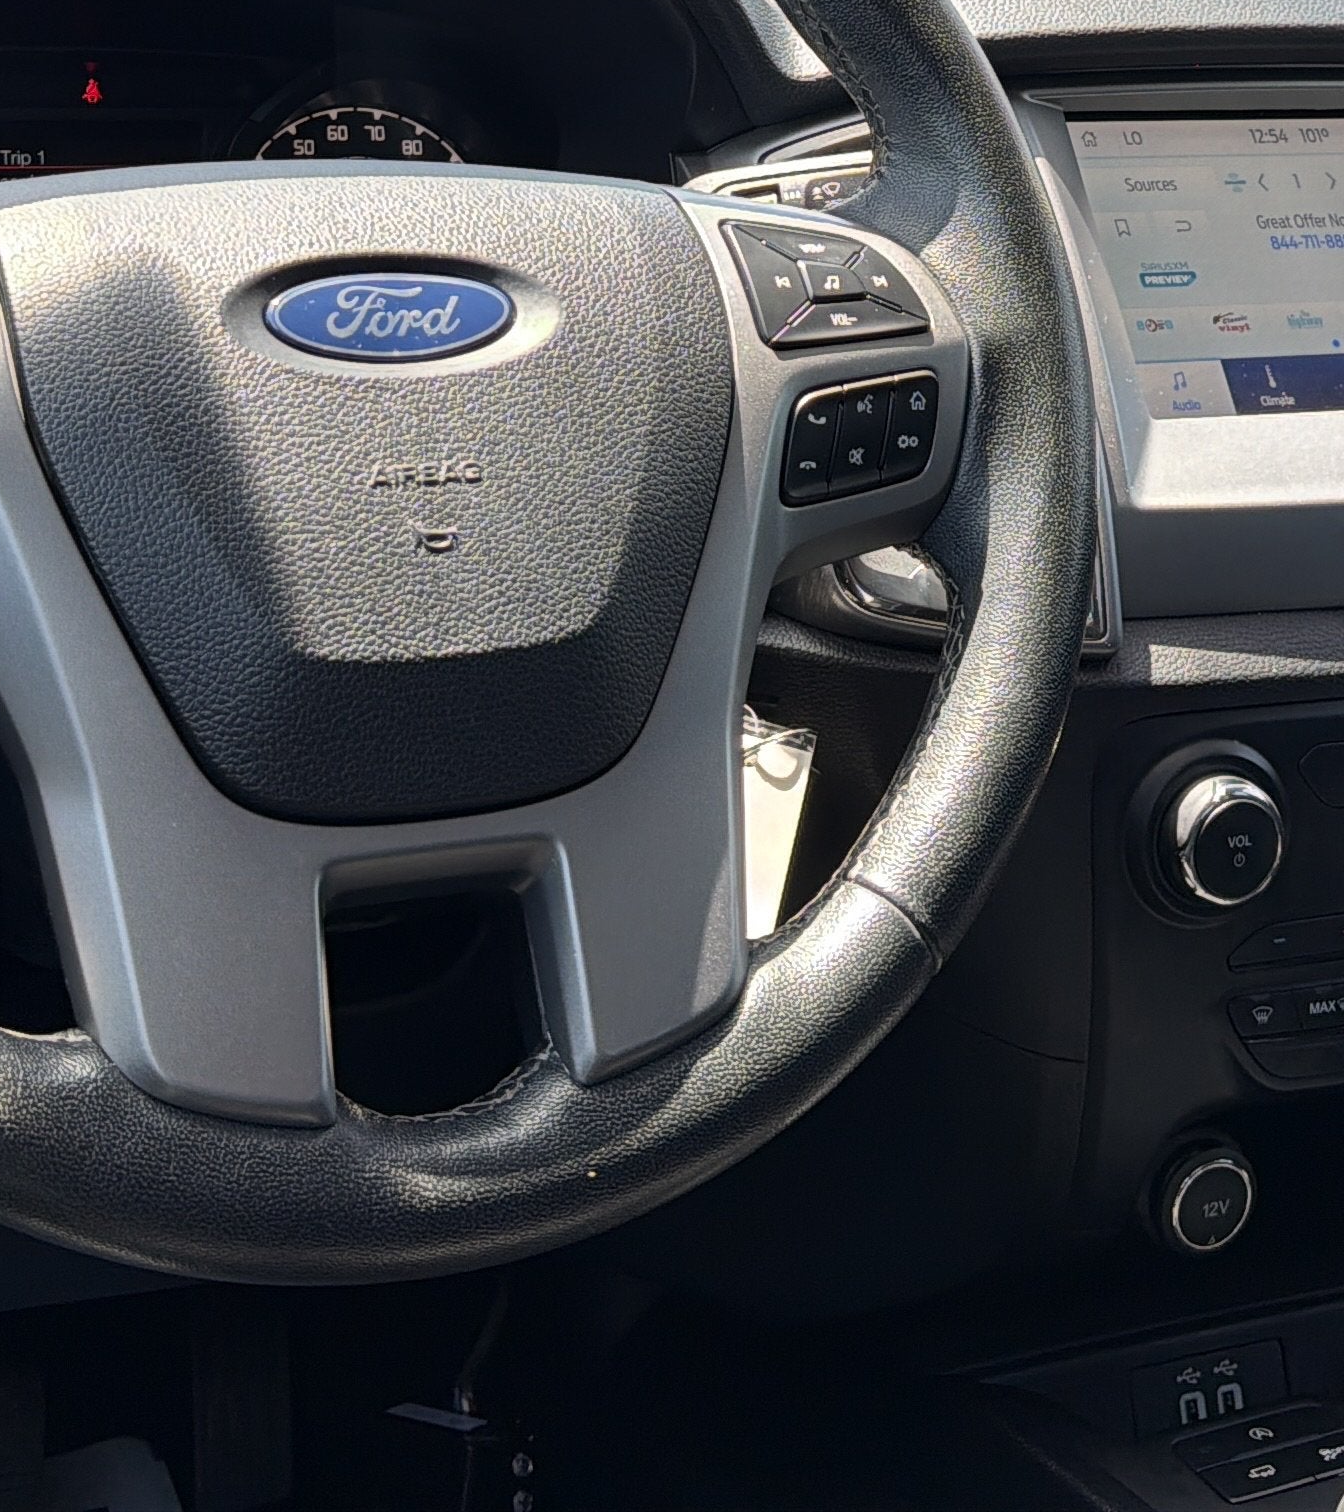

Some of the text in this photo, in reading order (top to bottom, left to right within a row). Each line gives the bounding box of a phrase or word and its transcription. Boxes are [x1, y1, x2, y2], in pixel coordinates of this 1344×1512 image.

[326, 125, 349, 141] 60
[363, 125, 386, 141] 70
[1123, 131, 1143, 146] LO
[1249, 128, 1289, 144] 12:54
[293, 139, 315, 156] 50
[401, 139, 423, 156] 80
[0, 150, 46, 167] Trip 1
[1124, 177, 1178, 193] Sources
[1256, 215, 1293, 230] Great
[1293, 214, 1327, 229] Offer
[1144, 274, 1192, 285] PREVIEW
[326, 285, 460, 338] Ford
[1172, 399, 1201, 411] Audio
[1260, 393, 1296, 408] Climate
[1227, 834, 1253, 848] VOL
[1309, 999, 1336, 1014] MAX
[1201, 1198, 1230, 1219] 12V
